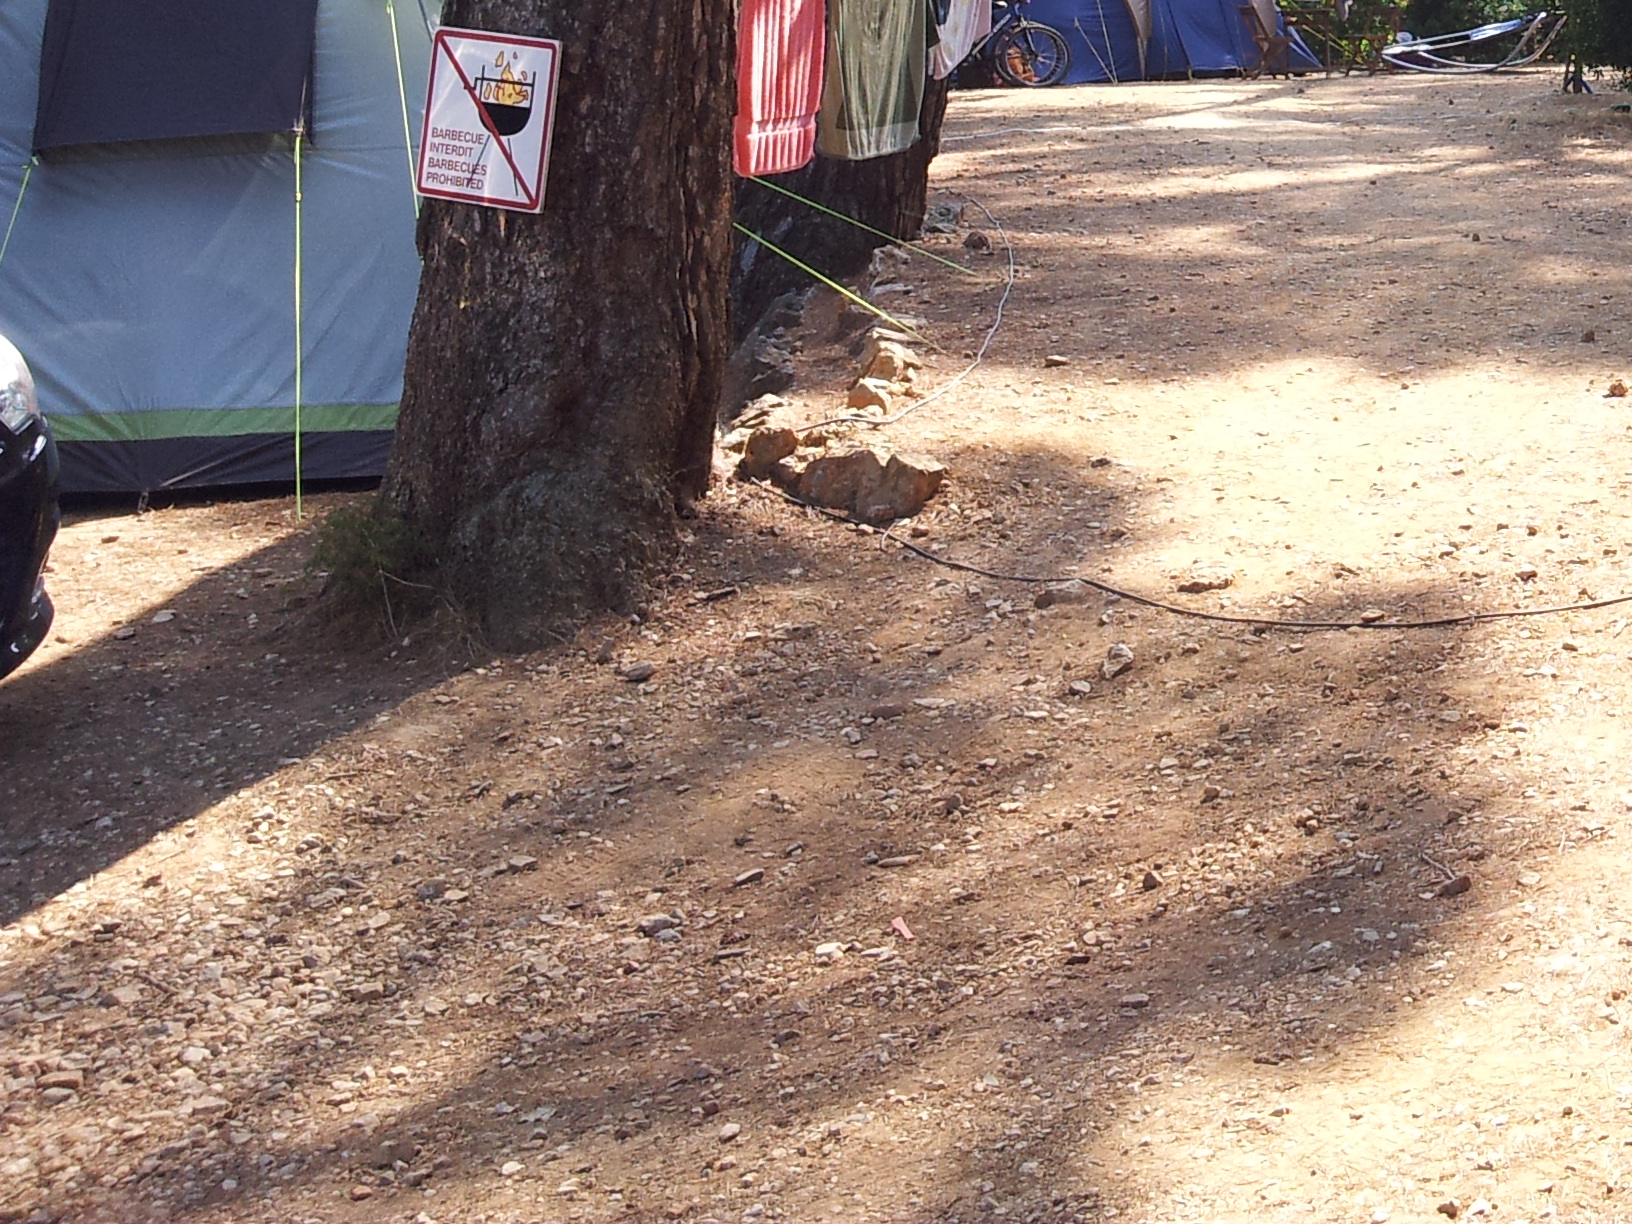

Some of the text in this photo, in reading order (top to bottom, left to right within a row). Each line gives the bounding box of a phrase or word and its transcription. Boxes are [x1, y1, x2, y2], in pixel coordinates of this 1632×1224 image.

[431, 127, 484, 145] BARBECUE
[429, 142, 474, 157] INTERDIT
[428, 157, 487, 176] BARBECUES
[426, 172, 484, 190] PROHIBITED
